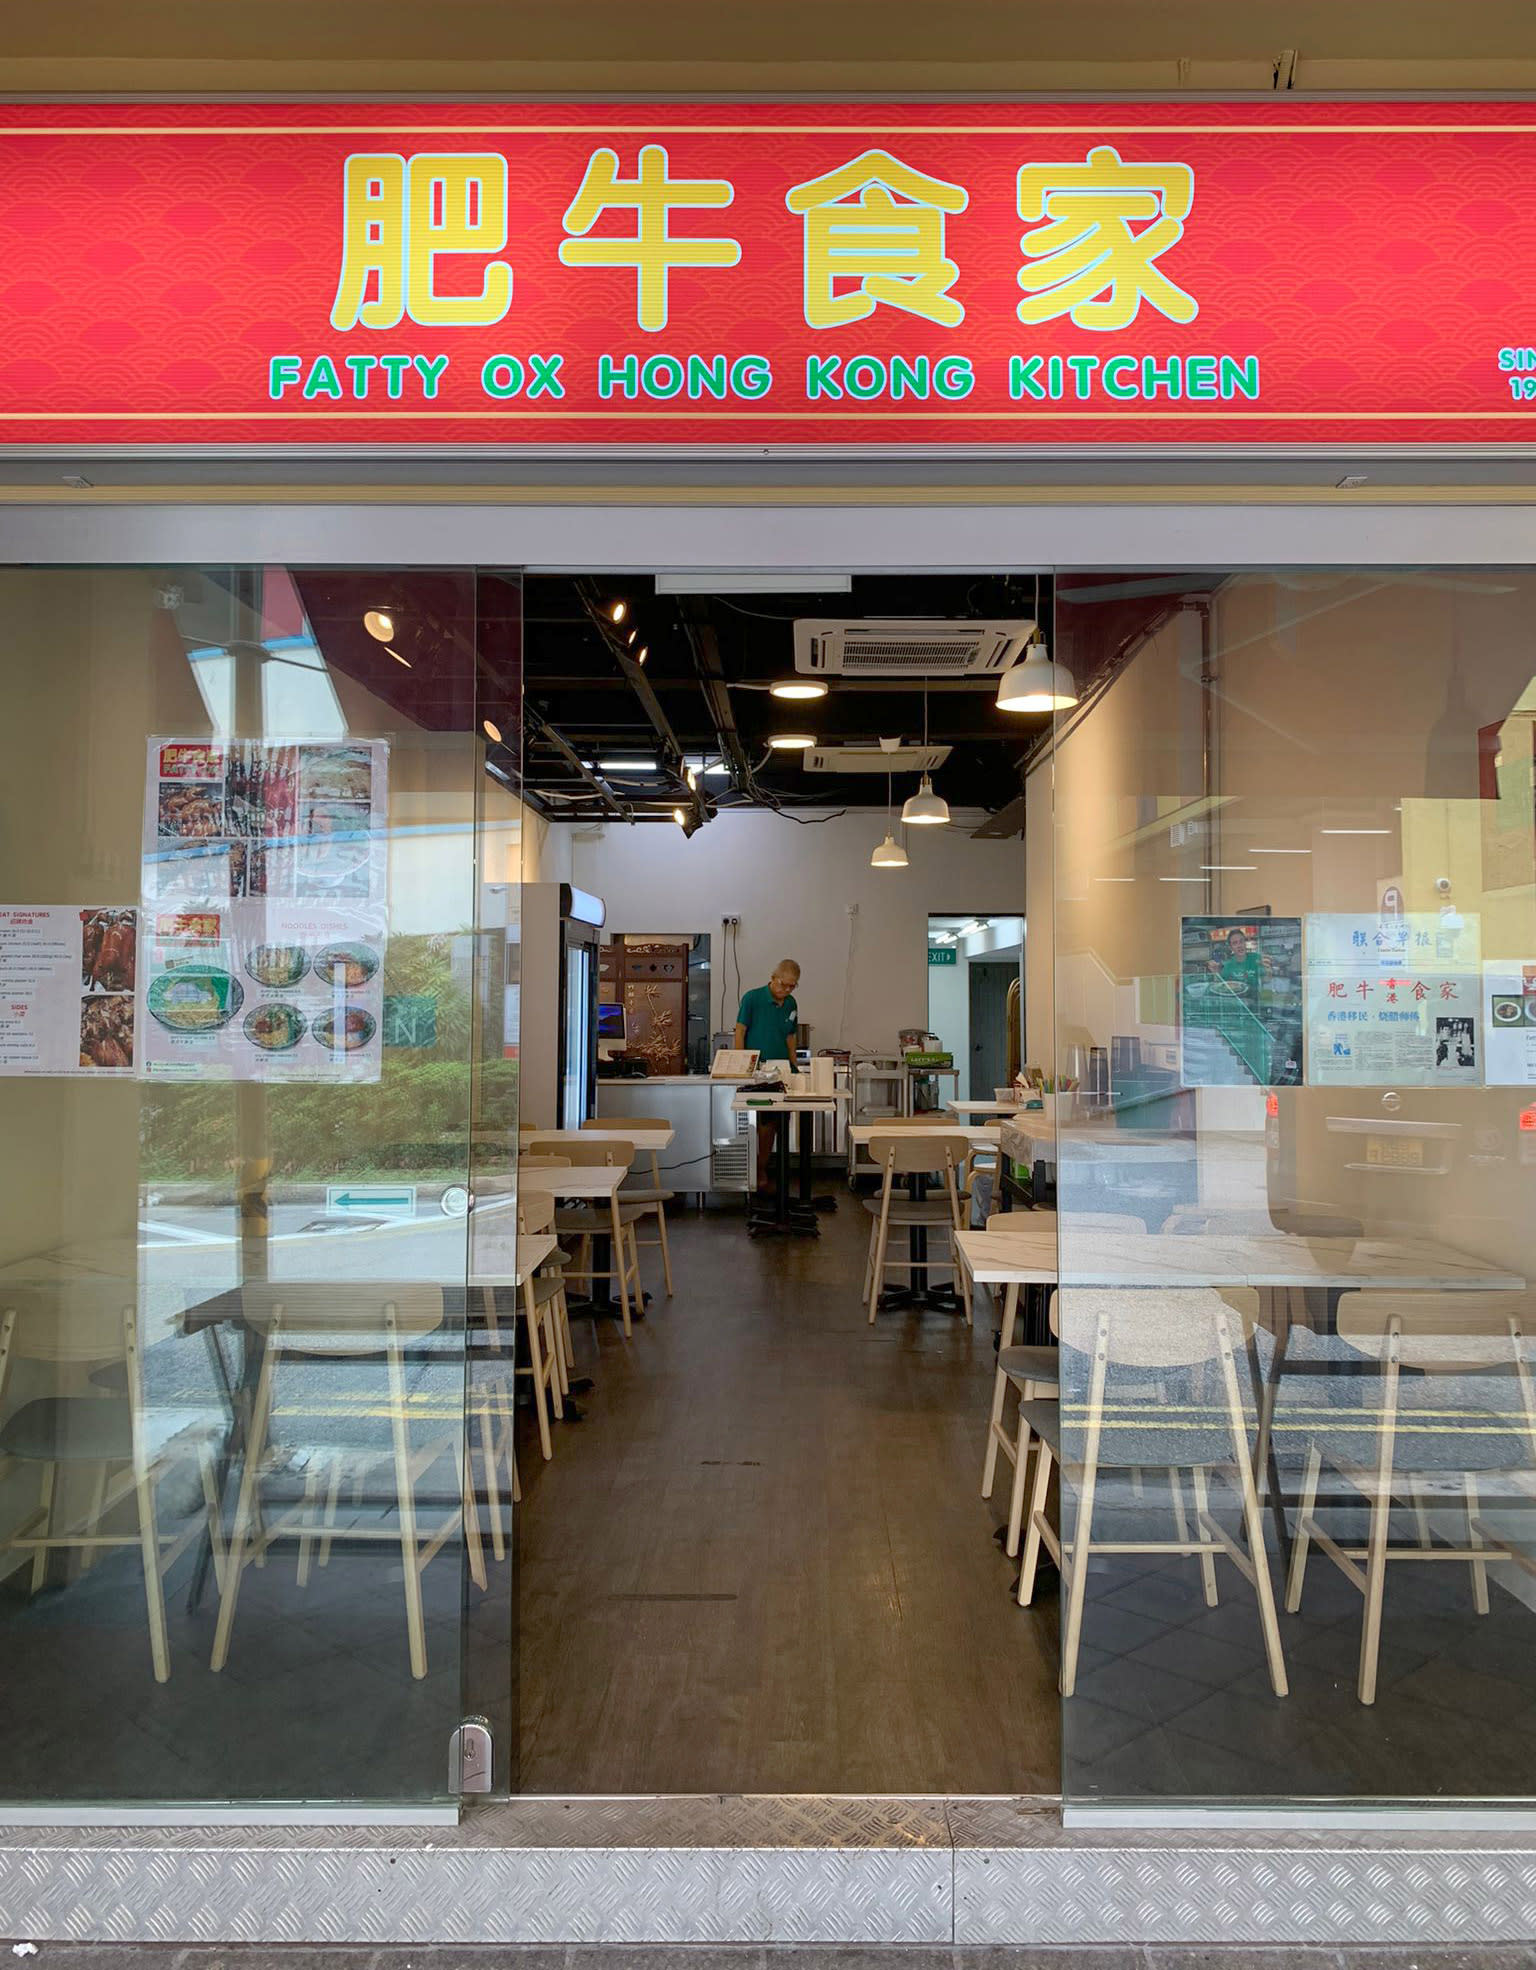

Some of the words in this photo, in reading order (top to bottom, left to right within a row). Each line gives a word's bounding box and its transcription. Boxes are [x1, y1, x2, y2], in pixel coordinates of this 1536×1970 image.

[330, 144, 1200, 333] 肥牛食家
[268, 354, 449, 400] FATTY
[481, 354, 566, 400] OX
[597, 354, 773, 400] HONG
[806, 354, 976, 400] KONG
[1008, 354, 1261, 400] KITCHEN
